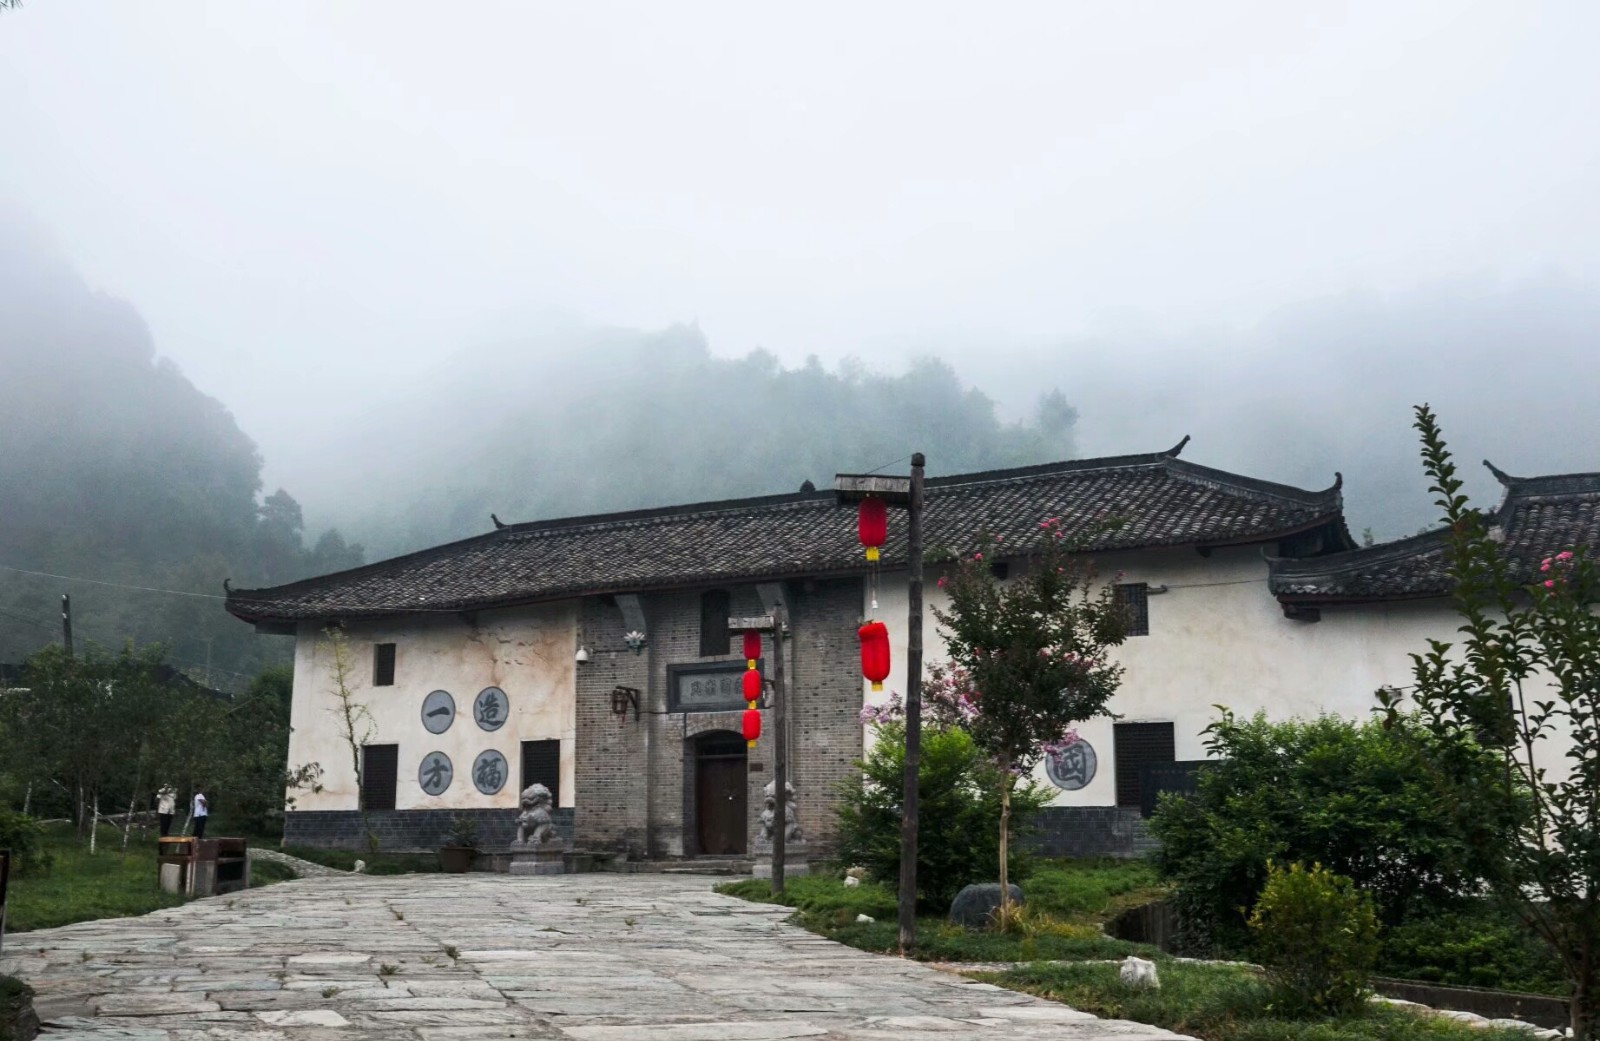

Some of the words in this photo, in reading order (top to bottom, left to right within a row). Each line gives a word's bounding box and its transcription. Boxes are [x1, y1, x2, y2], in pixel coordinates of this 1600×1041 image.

[426, 706, 450, 718] 一
[478, 692, 503, 726] 造
[423, 758, 449, 789] 方
[476, 757, 502, 789] 福
